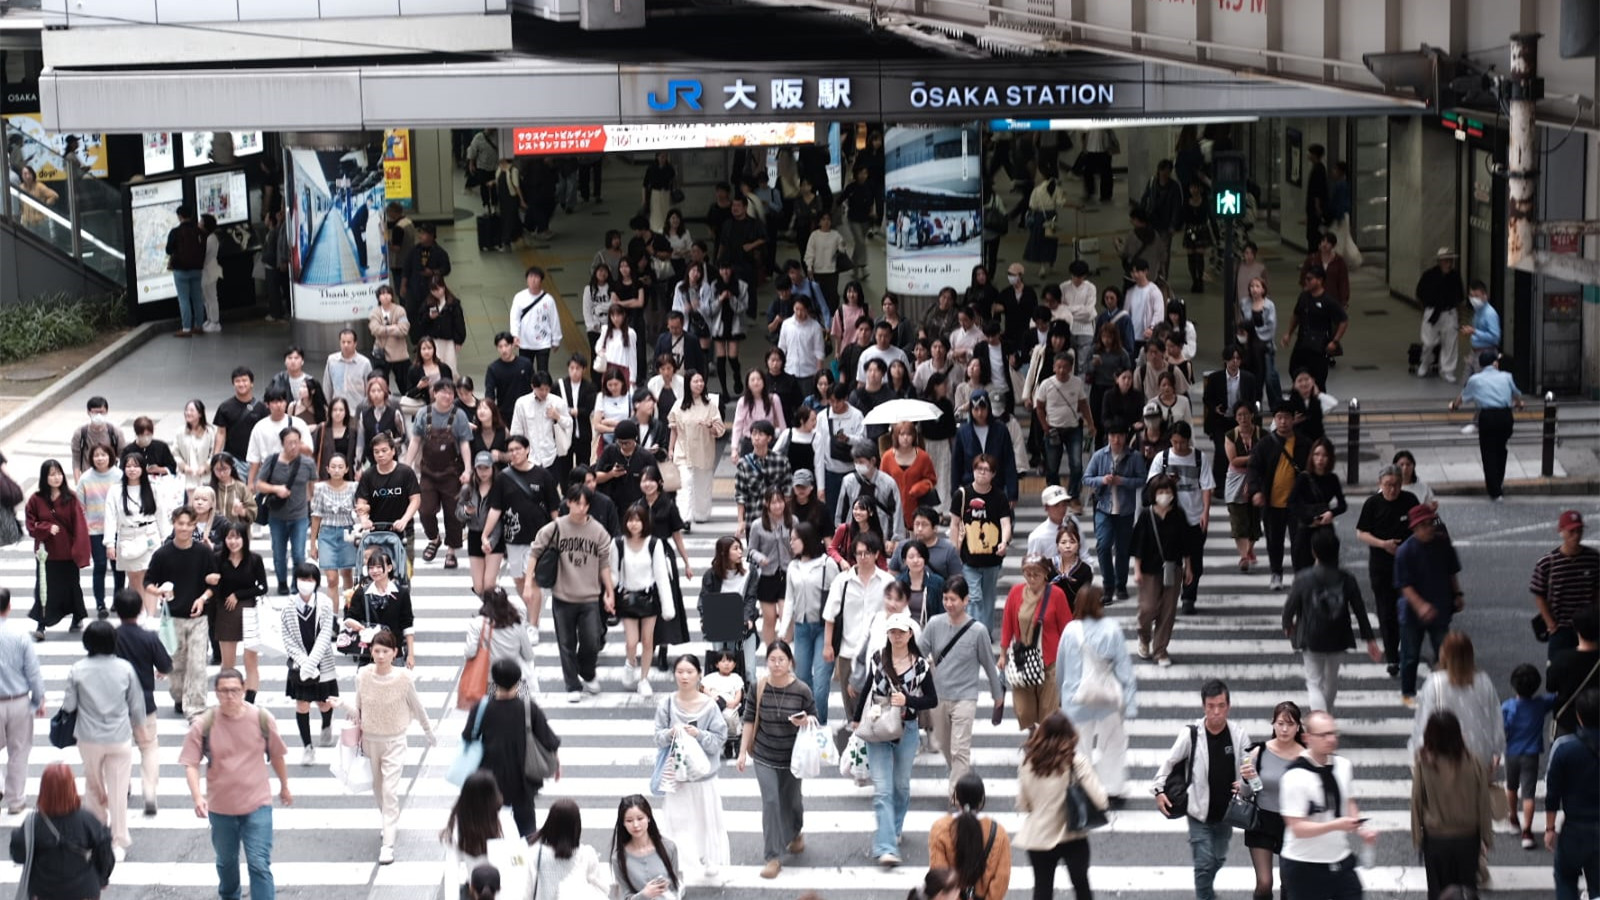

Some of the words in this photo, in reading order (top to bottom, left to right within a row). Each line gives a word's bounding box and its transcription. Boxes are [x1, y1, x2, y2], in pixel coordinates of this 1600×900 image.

[8, 93, 37, 102] OSAKA
[648, 79, 703, 110] JR
[723, 78, 852, 110] 大阪駅
[1006, 84, 1115, 106] STATION
[907, 266, 923, 276] you
[924, 263, 939, 274] for
[318, 287, 348, 299] Thank
[350, 289, 368, 300] you
[560, 537, 598, 557] BROOKLYN
